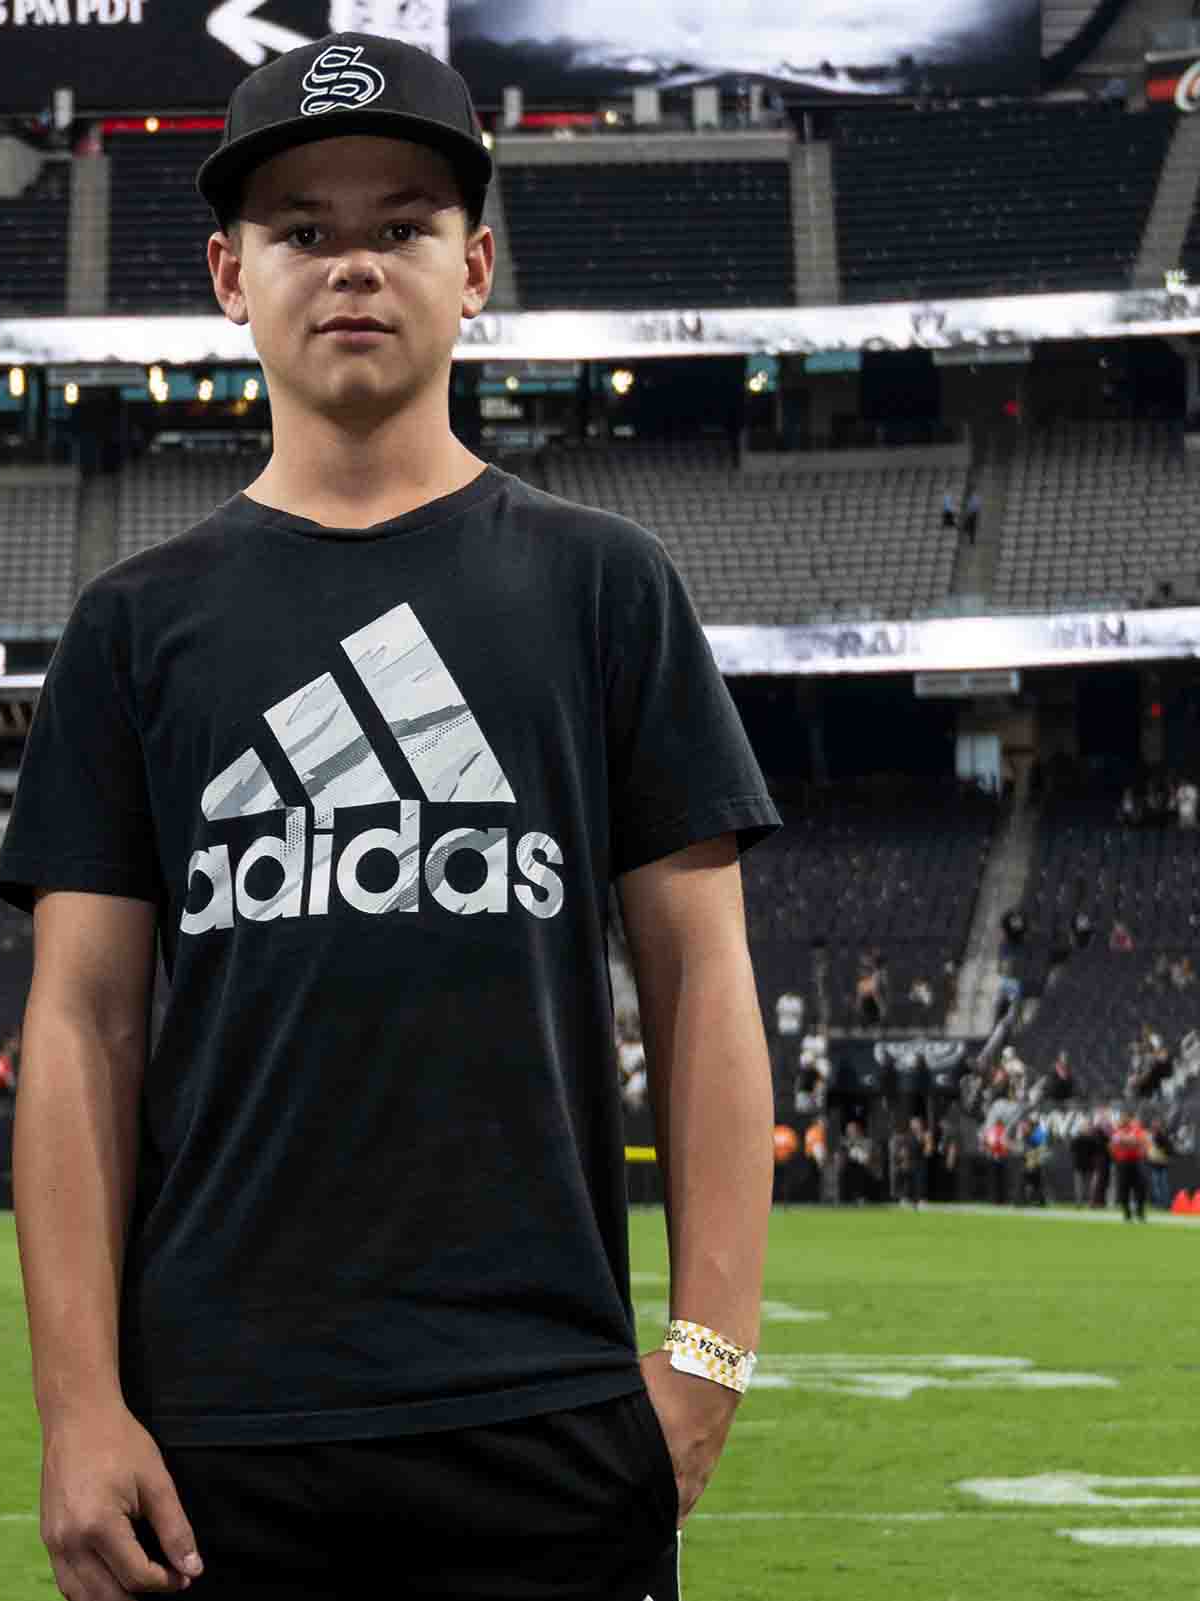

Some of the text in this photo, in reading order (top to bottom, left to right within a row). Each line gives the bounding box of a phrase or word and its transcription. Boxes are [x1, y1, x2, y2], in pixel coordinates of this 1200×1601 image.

[13, 0, 70, 25] PM
[76, 0, 145, 24] PDT
[178, 800, 564, 935] adidas
[699, 1339, 741, 1367] 09.29.24
